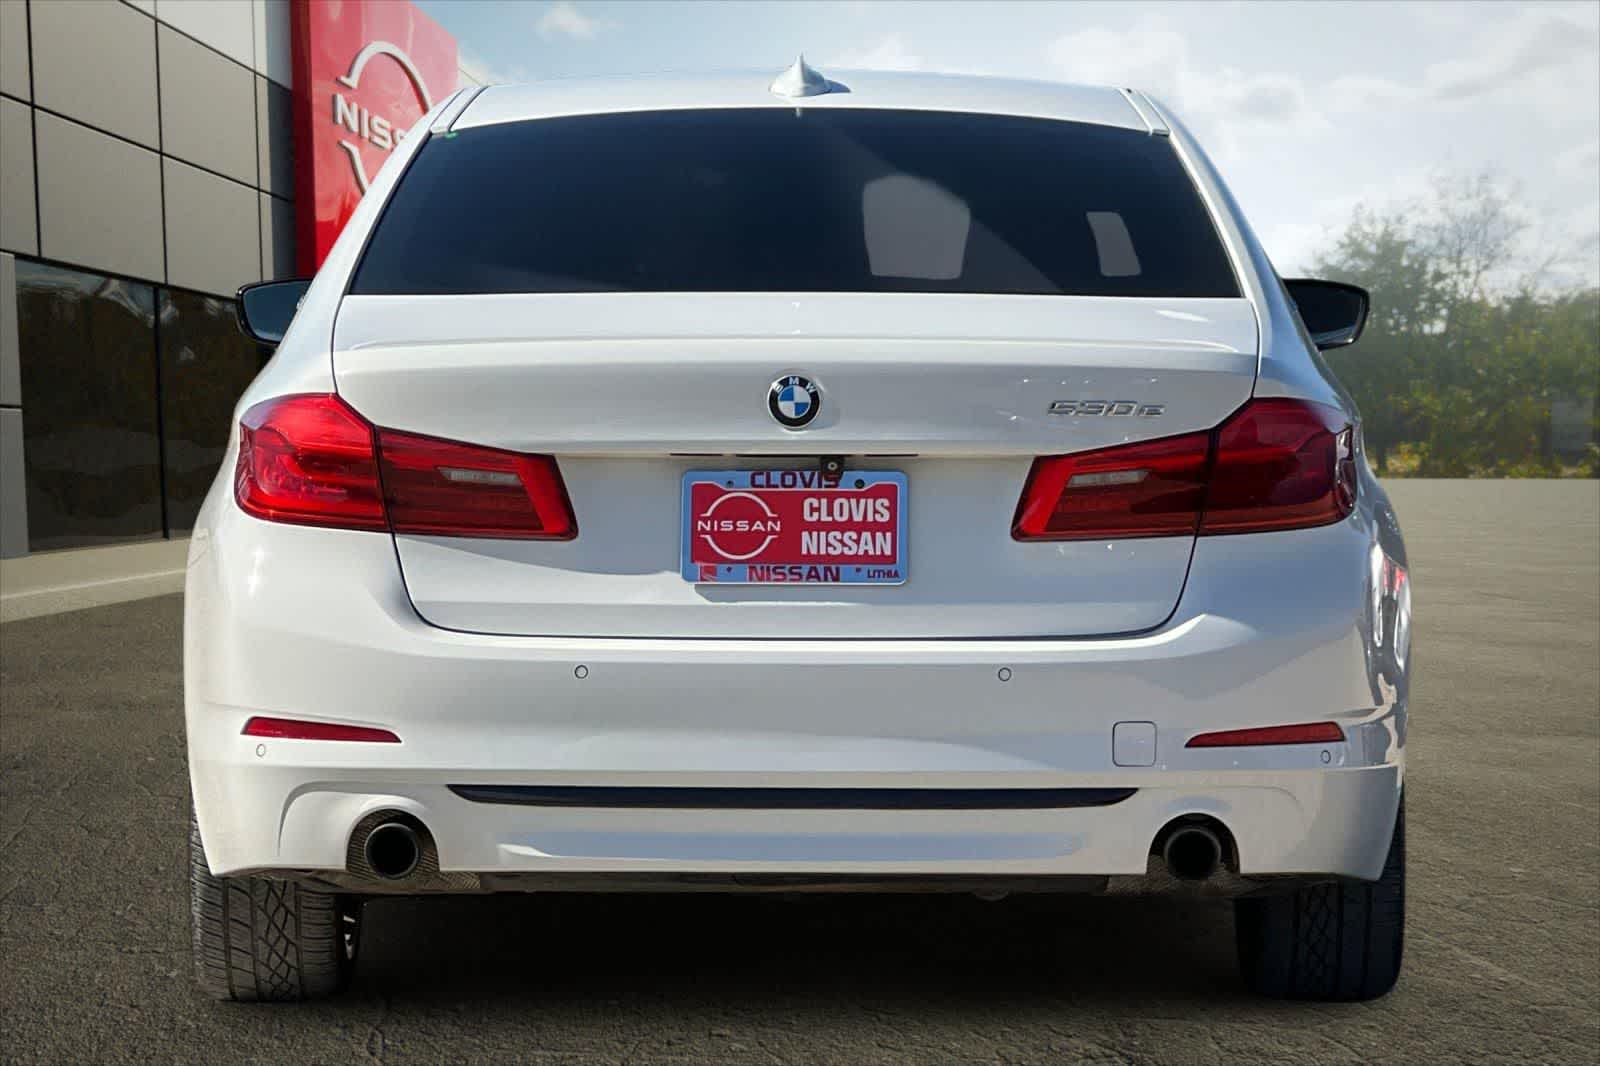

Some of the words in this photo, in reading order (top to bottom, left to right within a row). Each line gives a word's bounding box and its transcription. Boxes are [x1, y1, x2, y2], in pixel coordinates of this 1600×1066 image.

[772, 376, 817, 393] BMW
[803, 498, 890, 522] CLOVIS
[697, 520, 781, 532] NISSAN
[801, 531, 892, 556] NISSAN
[748, 566, 840, 582] NISSAN
[867, 570, 899, 579] LITHIA
